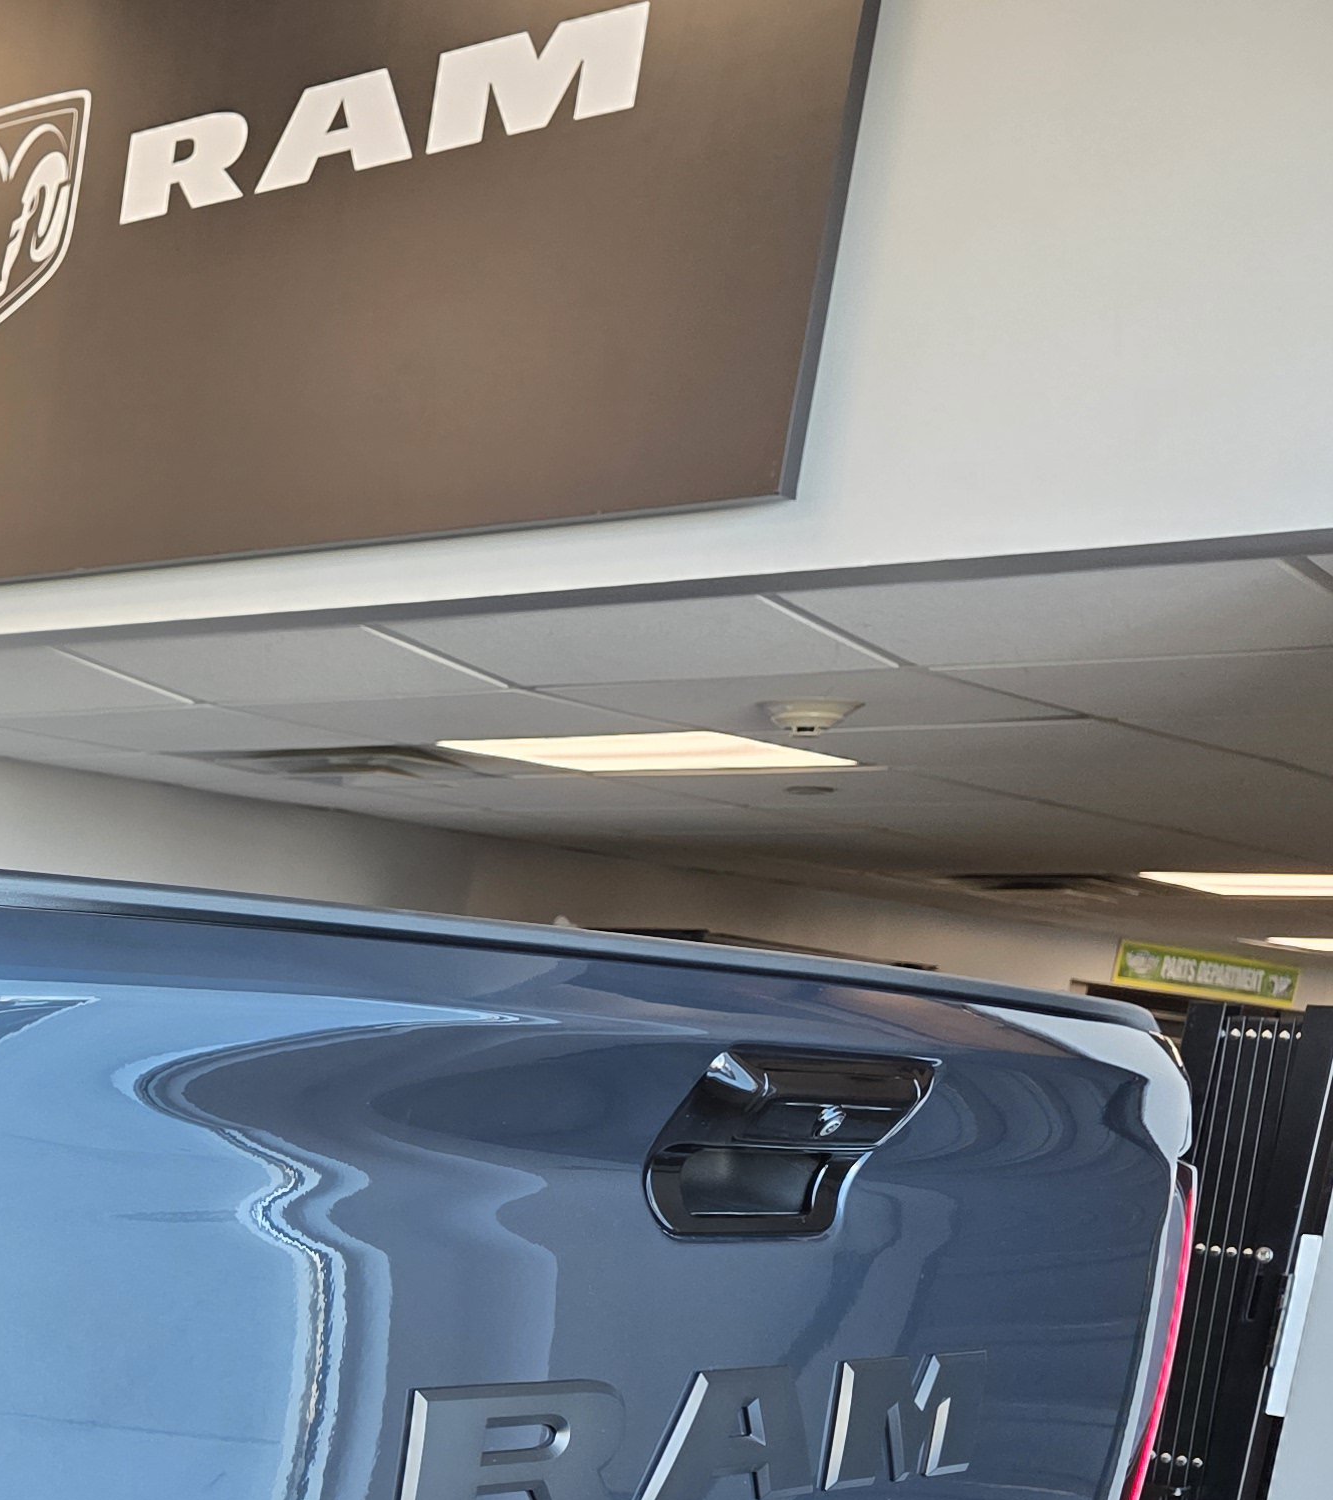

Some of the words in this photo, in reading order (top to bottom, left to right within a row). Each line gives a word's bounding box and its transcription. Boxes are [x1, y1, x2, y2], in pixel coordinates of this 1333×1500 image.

[119, 1, 651, 225] RAM
[1160, 955, 1197, 983] PARTS
[1196, 960, 1266, 994] DEPARTMENT
